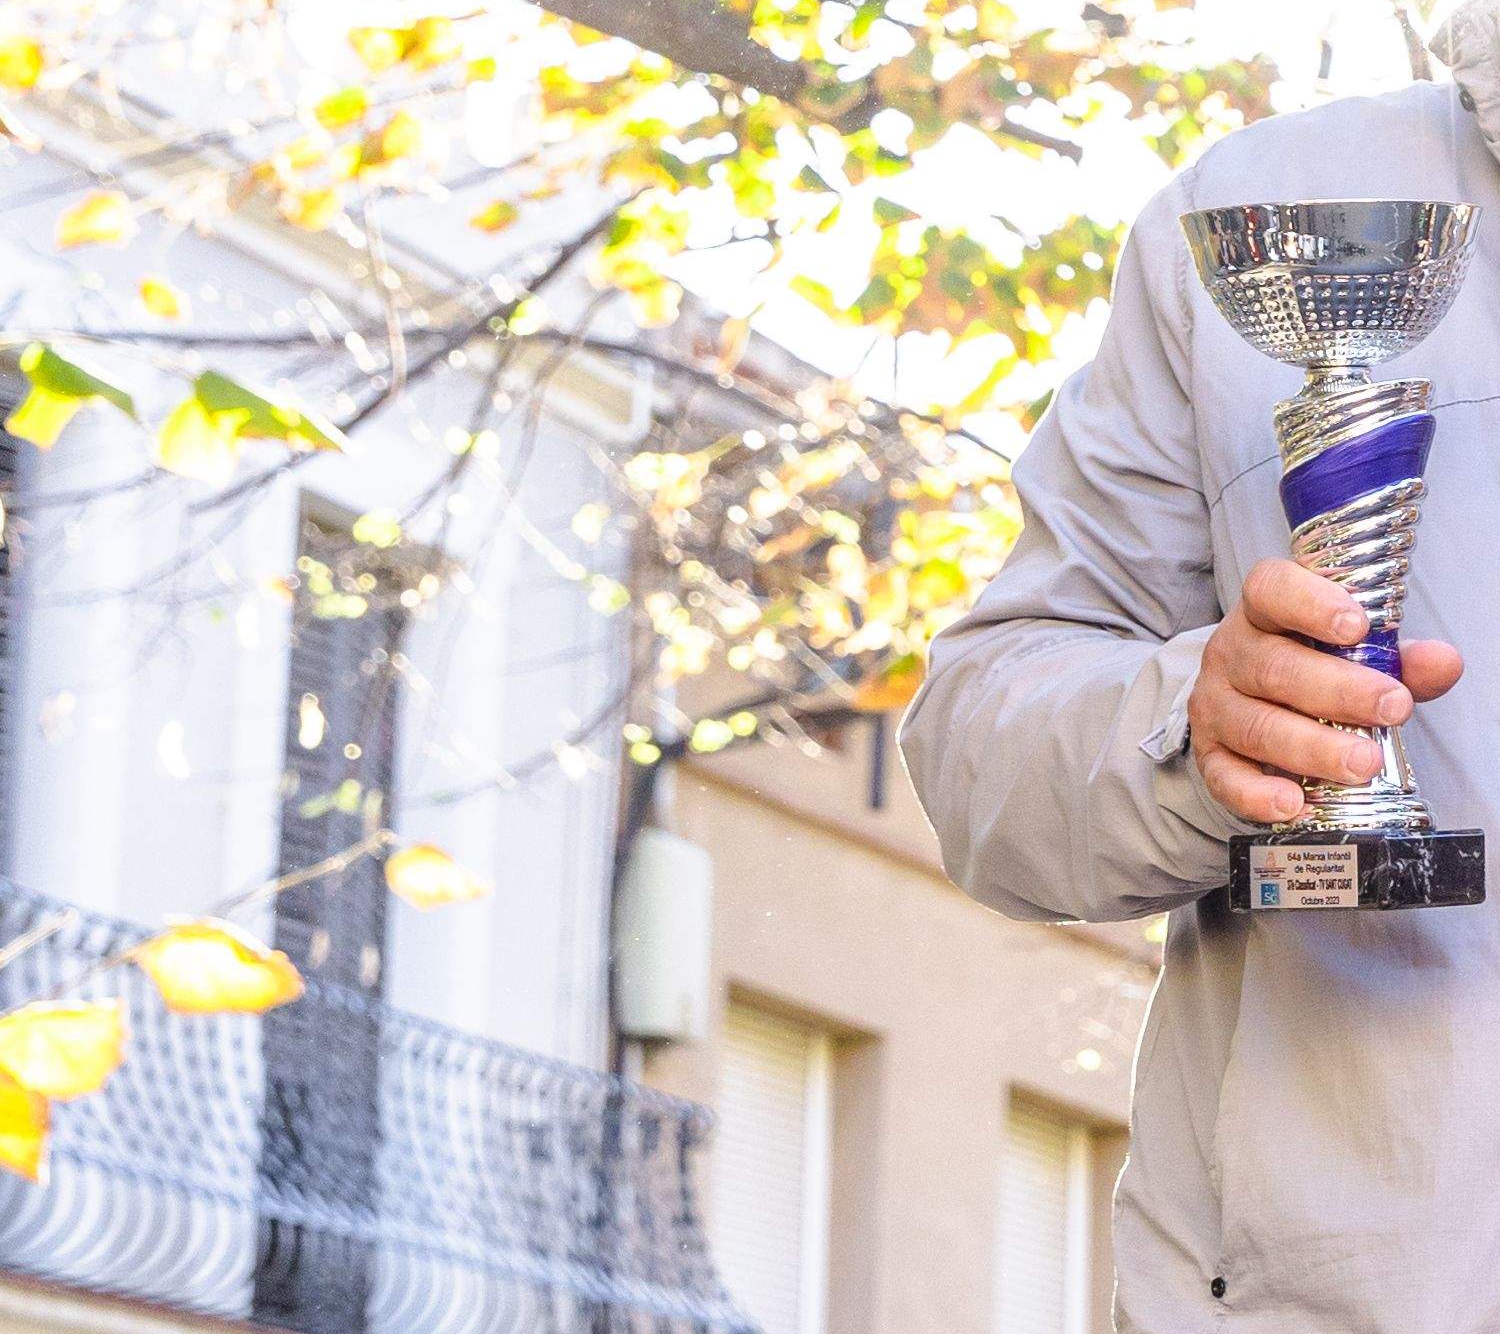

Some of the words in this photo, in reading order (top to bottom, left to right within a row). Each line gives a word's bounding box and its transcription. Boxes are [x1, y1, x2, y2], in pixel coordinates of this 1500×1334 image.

[1287, 853, 1301, 861] 64a
[1303, 852, 1326, 861] Marxa
[1328, 851, 1351, 860] Infantil
[1295, 865, 1303, 873] de
[1306, 864, 1344, 875] Regularitat
[1301, 897, 1324, 905] Octubre
[1326, 896, 1339, 905] 2023
